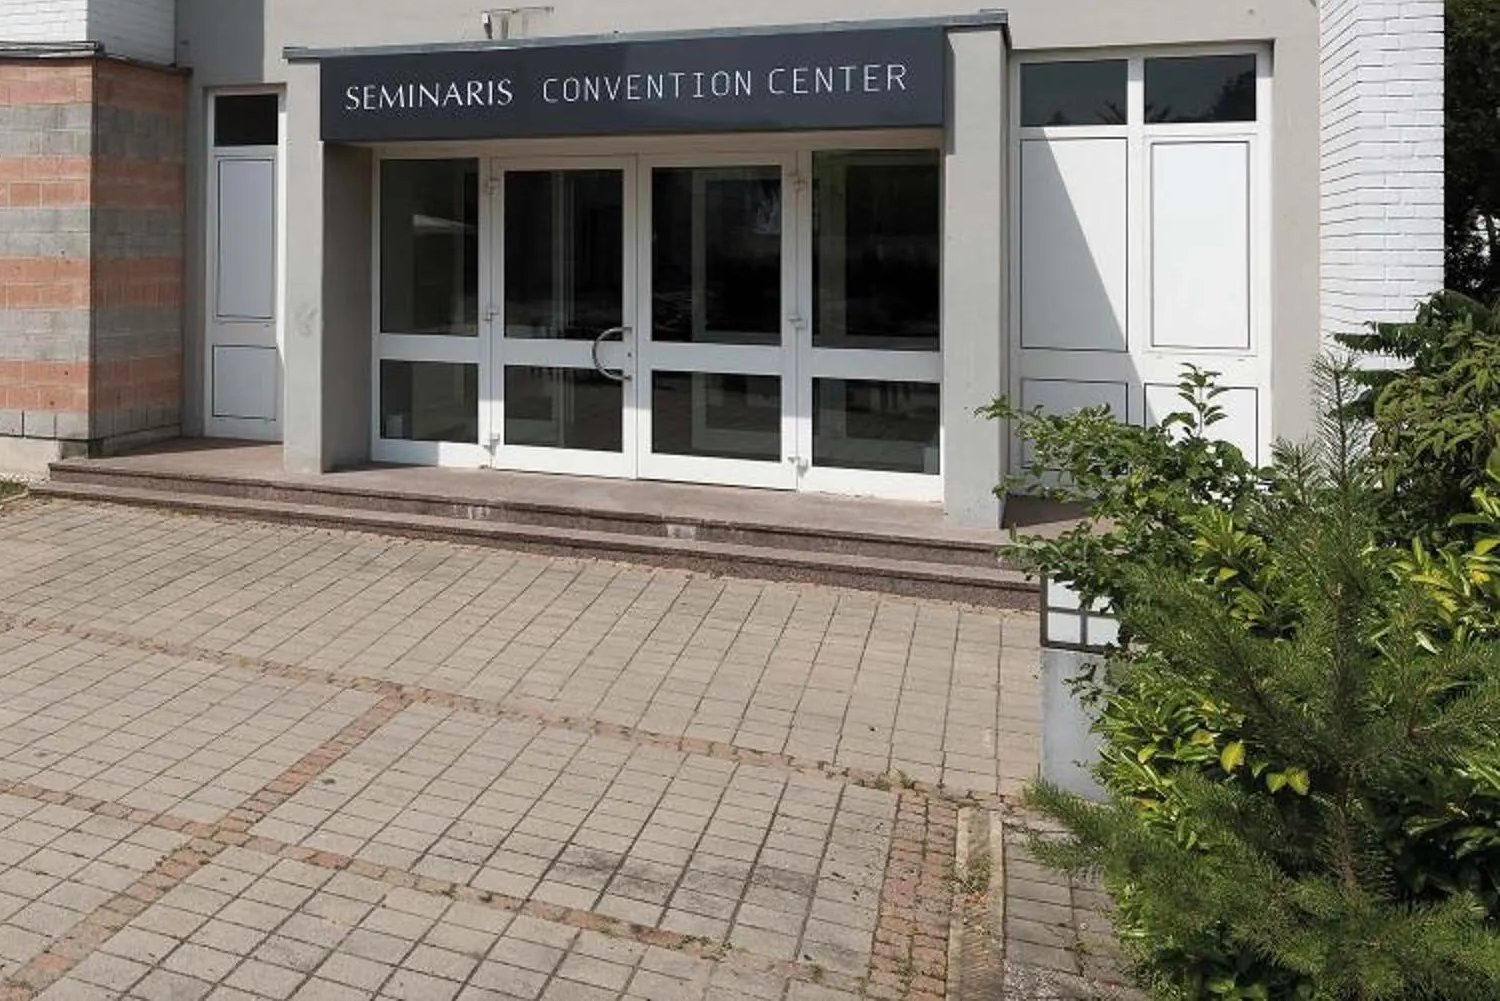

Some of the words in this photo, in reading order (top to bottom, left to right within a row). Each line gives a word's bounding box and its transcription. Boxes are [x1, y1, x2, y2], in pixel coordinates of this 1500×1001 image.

[345, 79, 514, 111] SEMINARIS
[542, 69, 752, 103] CONVENTION
[767, 63, 908, 97] CENTER
